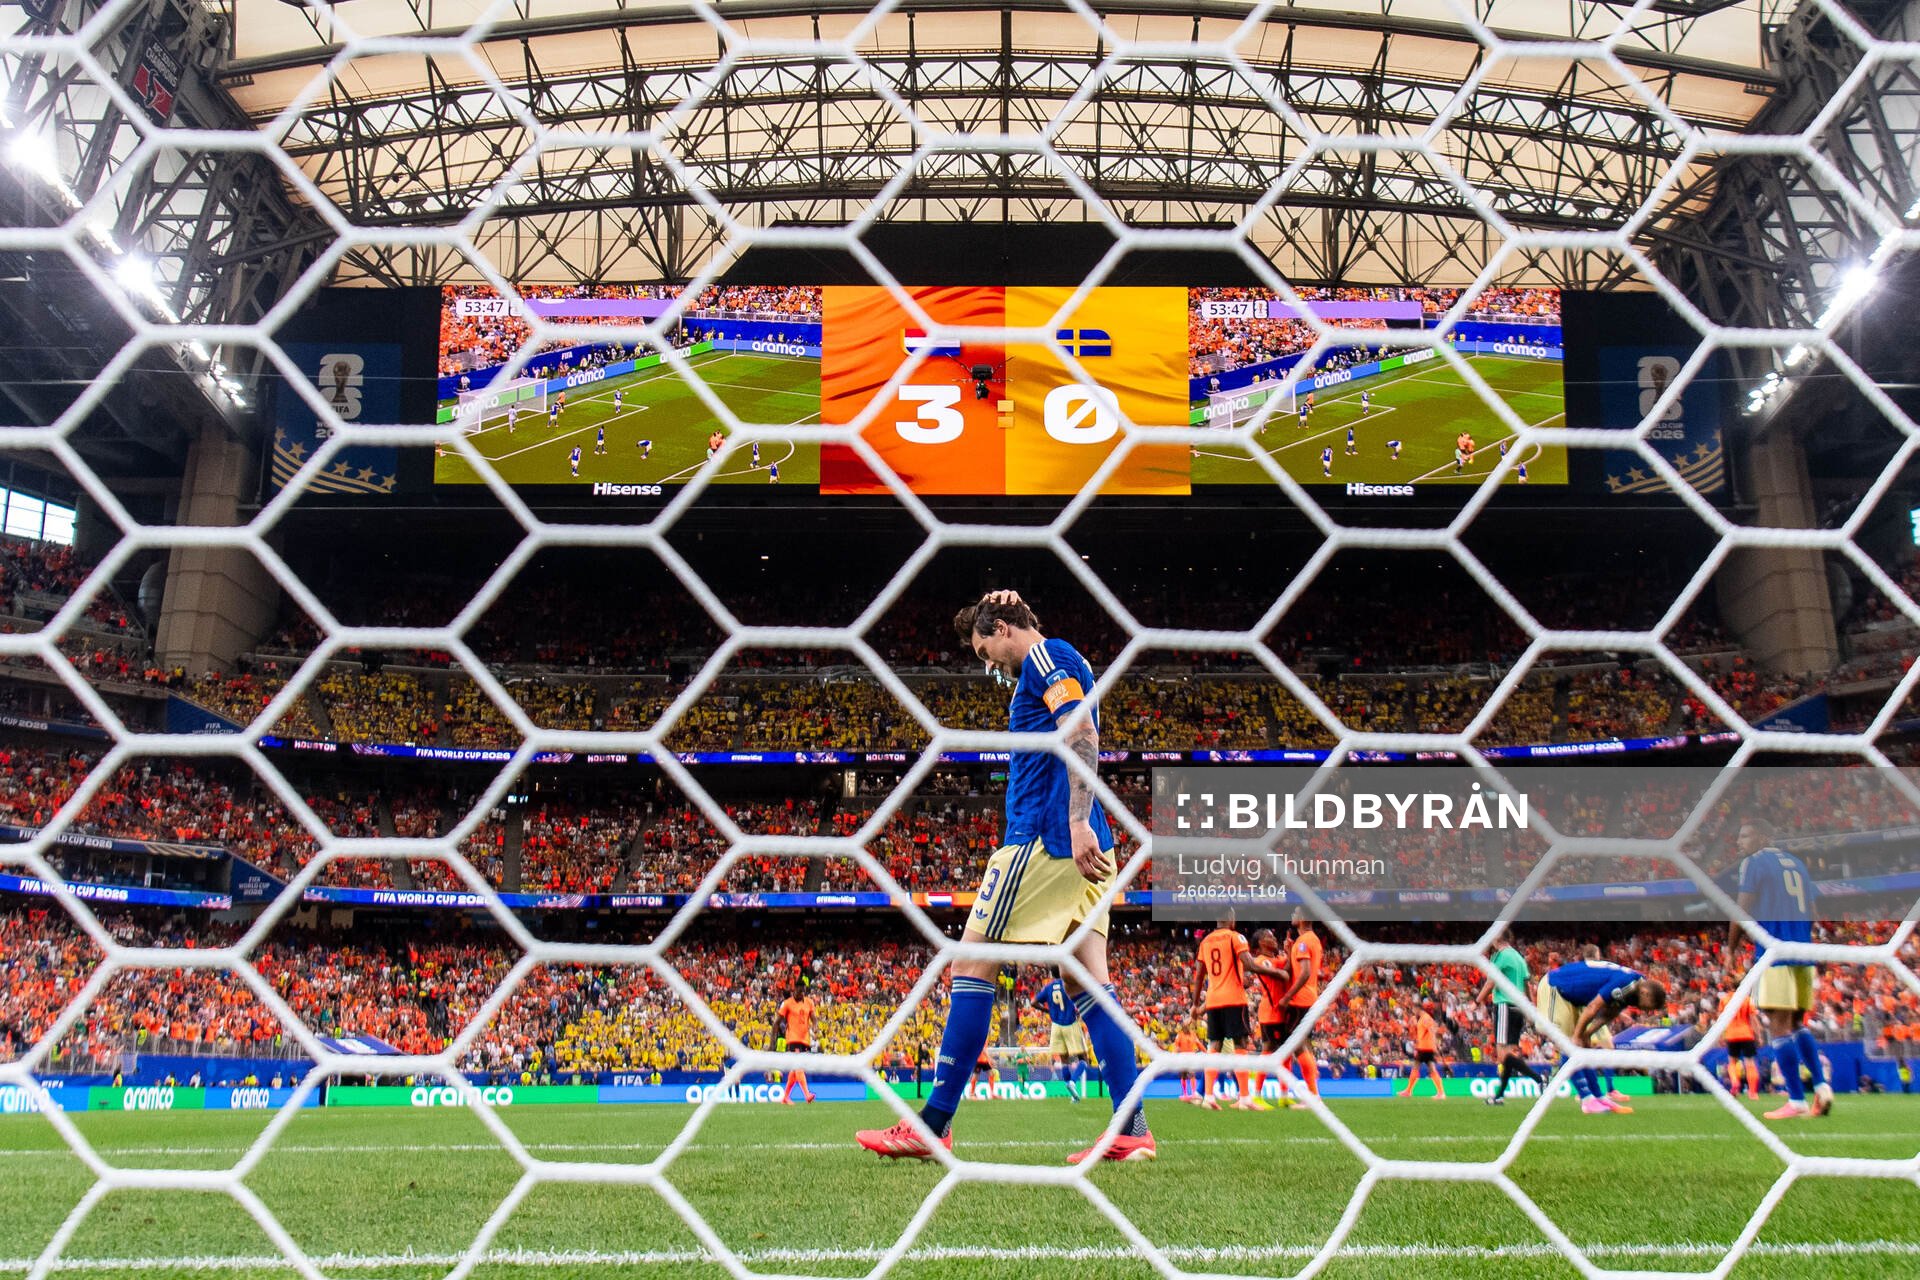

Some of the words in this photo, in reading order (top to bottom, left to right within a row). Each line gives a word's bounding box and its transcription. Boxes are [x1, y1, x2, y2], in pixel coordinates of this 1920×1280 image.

[464, 301, 504, 313] 53:47
[1209, 304, 1248, 316] 53:47
[752, 341, 806, 356] aramco
[1493, 342, 1547, 357] aramco
[566, 368, 606, 388] aramco
[1313, 369, 1352, 388] aramco
[895, 384, 965, 444] 3
[1043, 384, 1120, 444] 0
[593, 482, 662, 496] Hisense
[1346, 482, 1415, 496] Hisense
[18, 719, 48, 730] 2026
[415, 748, 434, 757] FIFA
[434, 749, 464, 759] WORLD
[464, 750, 482, 760] CUP
[481, 751, 511, 761] 2026
[1531, 747, 1549, 755] FIFA
[1578, 743, 1595, 752] CUP
[865, 753, 906, 762] HOUSTON
[979, 752, 996, 761] FIFA
[19, 879, 41, 892] FIFA
[41, 881, 77, 895] WOLD
[76, 885, 96, 898] CUP
[981, 868, 1001, 901] 3
[1782, 869, 1806, 914] 4
[373, 892, 396, 904] FIFA
[397, 893, 435, 905] WORLD
[435, 894, 457, 905] CUP
[611, 896, 664, 907] HOUSTON
[1210, 947, 1222, 977] 8
[1052, 990, 1065, 1011] 9
[613, 1074, 644, 1087] FIFA
[123, 1087, 175, 1111] aramco
[230, 1087, 270, 1109] aramco
